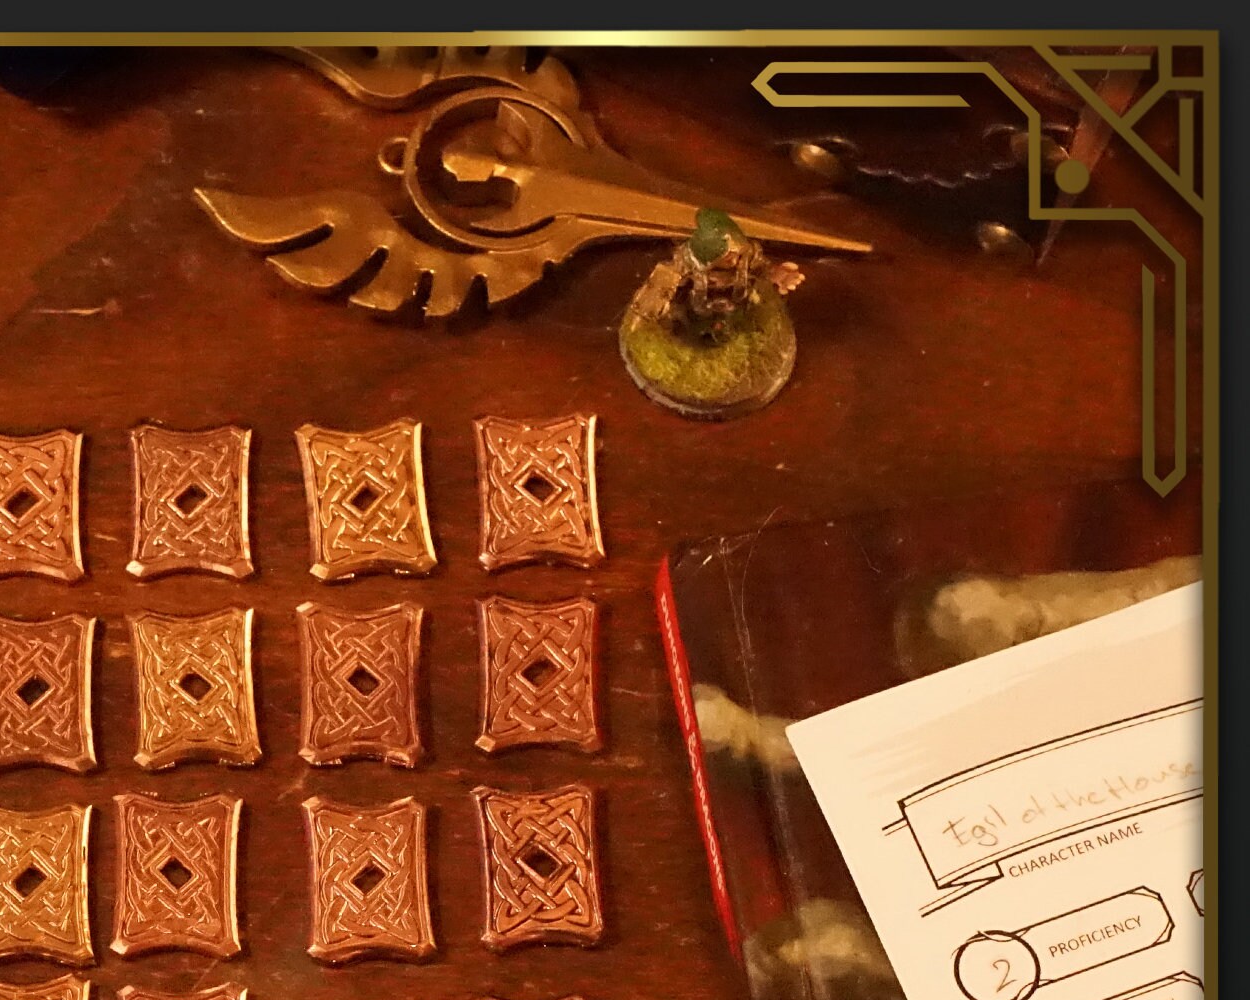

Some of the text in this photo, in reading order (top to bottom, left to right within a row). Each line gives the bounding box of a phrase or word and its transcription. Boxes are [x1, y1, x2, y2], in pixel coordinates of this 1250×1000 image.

[1008, 822, 1143, 878] CHARACTER NAME
[1048, 915, 1143, 958] PROFICIENCY
[992, 958, 1018, 993] 2
